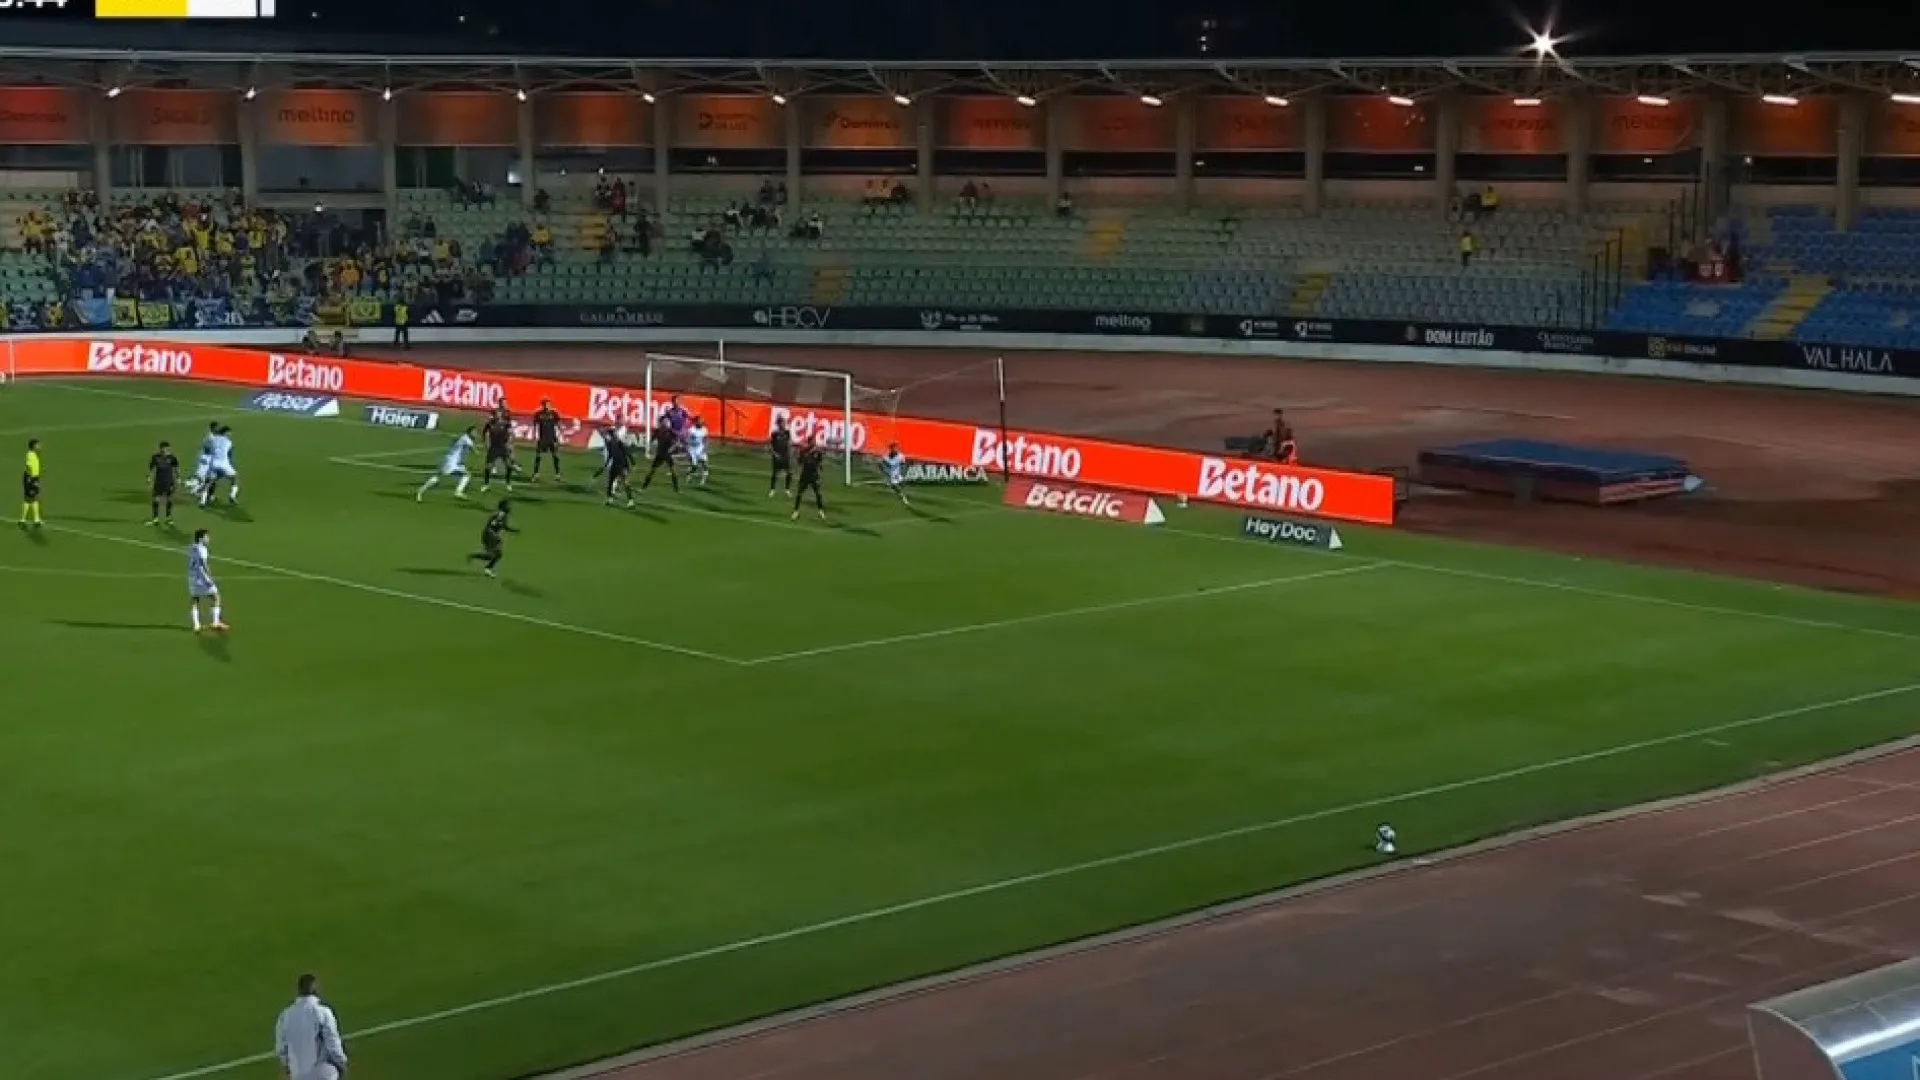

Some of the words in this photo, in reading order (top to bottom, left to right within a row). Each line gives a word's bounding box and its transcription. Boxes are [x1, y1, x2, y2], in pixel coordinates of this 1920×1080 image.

[1425, 328, 1452, 344] DOM
[87, 341, 193, 374] Betano
[267, 353, 344, 391] Betano
[422, 369, 505, 409] Betano
[970, 427, 1082, 477] Betano
[1025, 484, 1124, 517] Betclic
[1197, 456, 1324, 511] Betano
